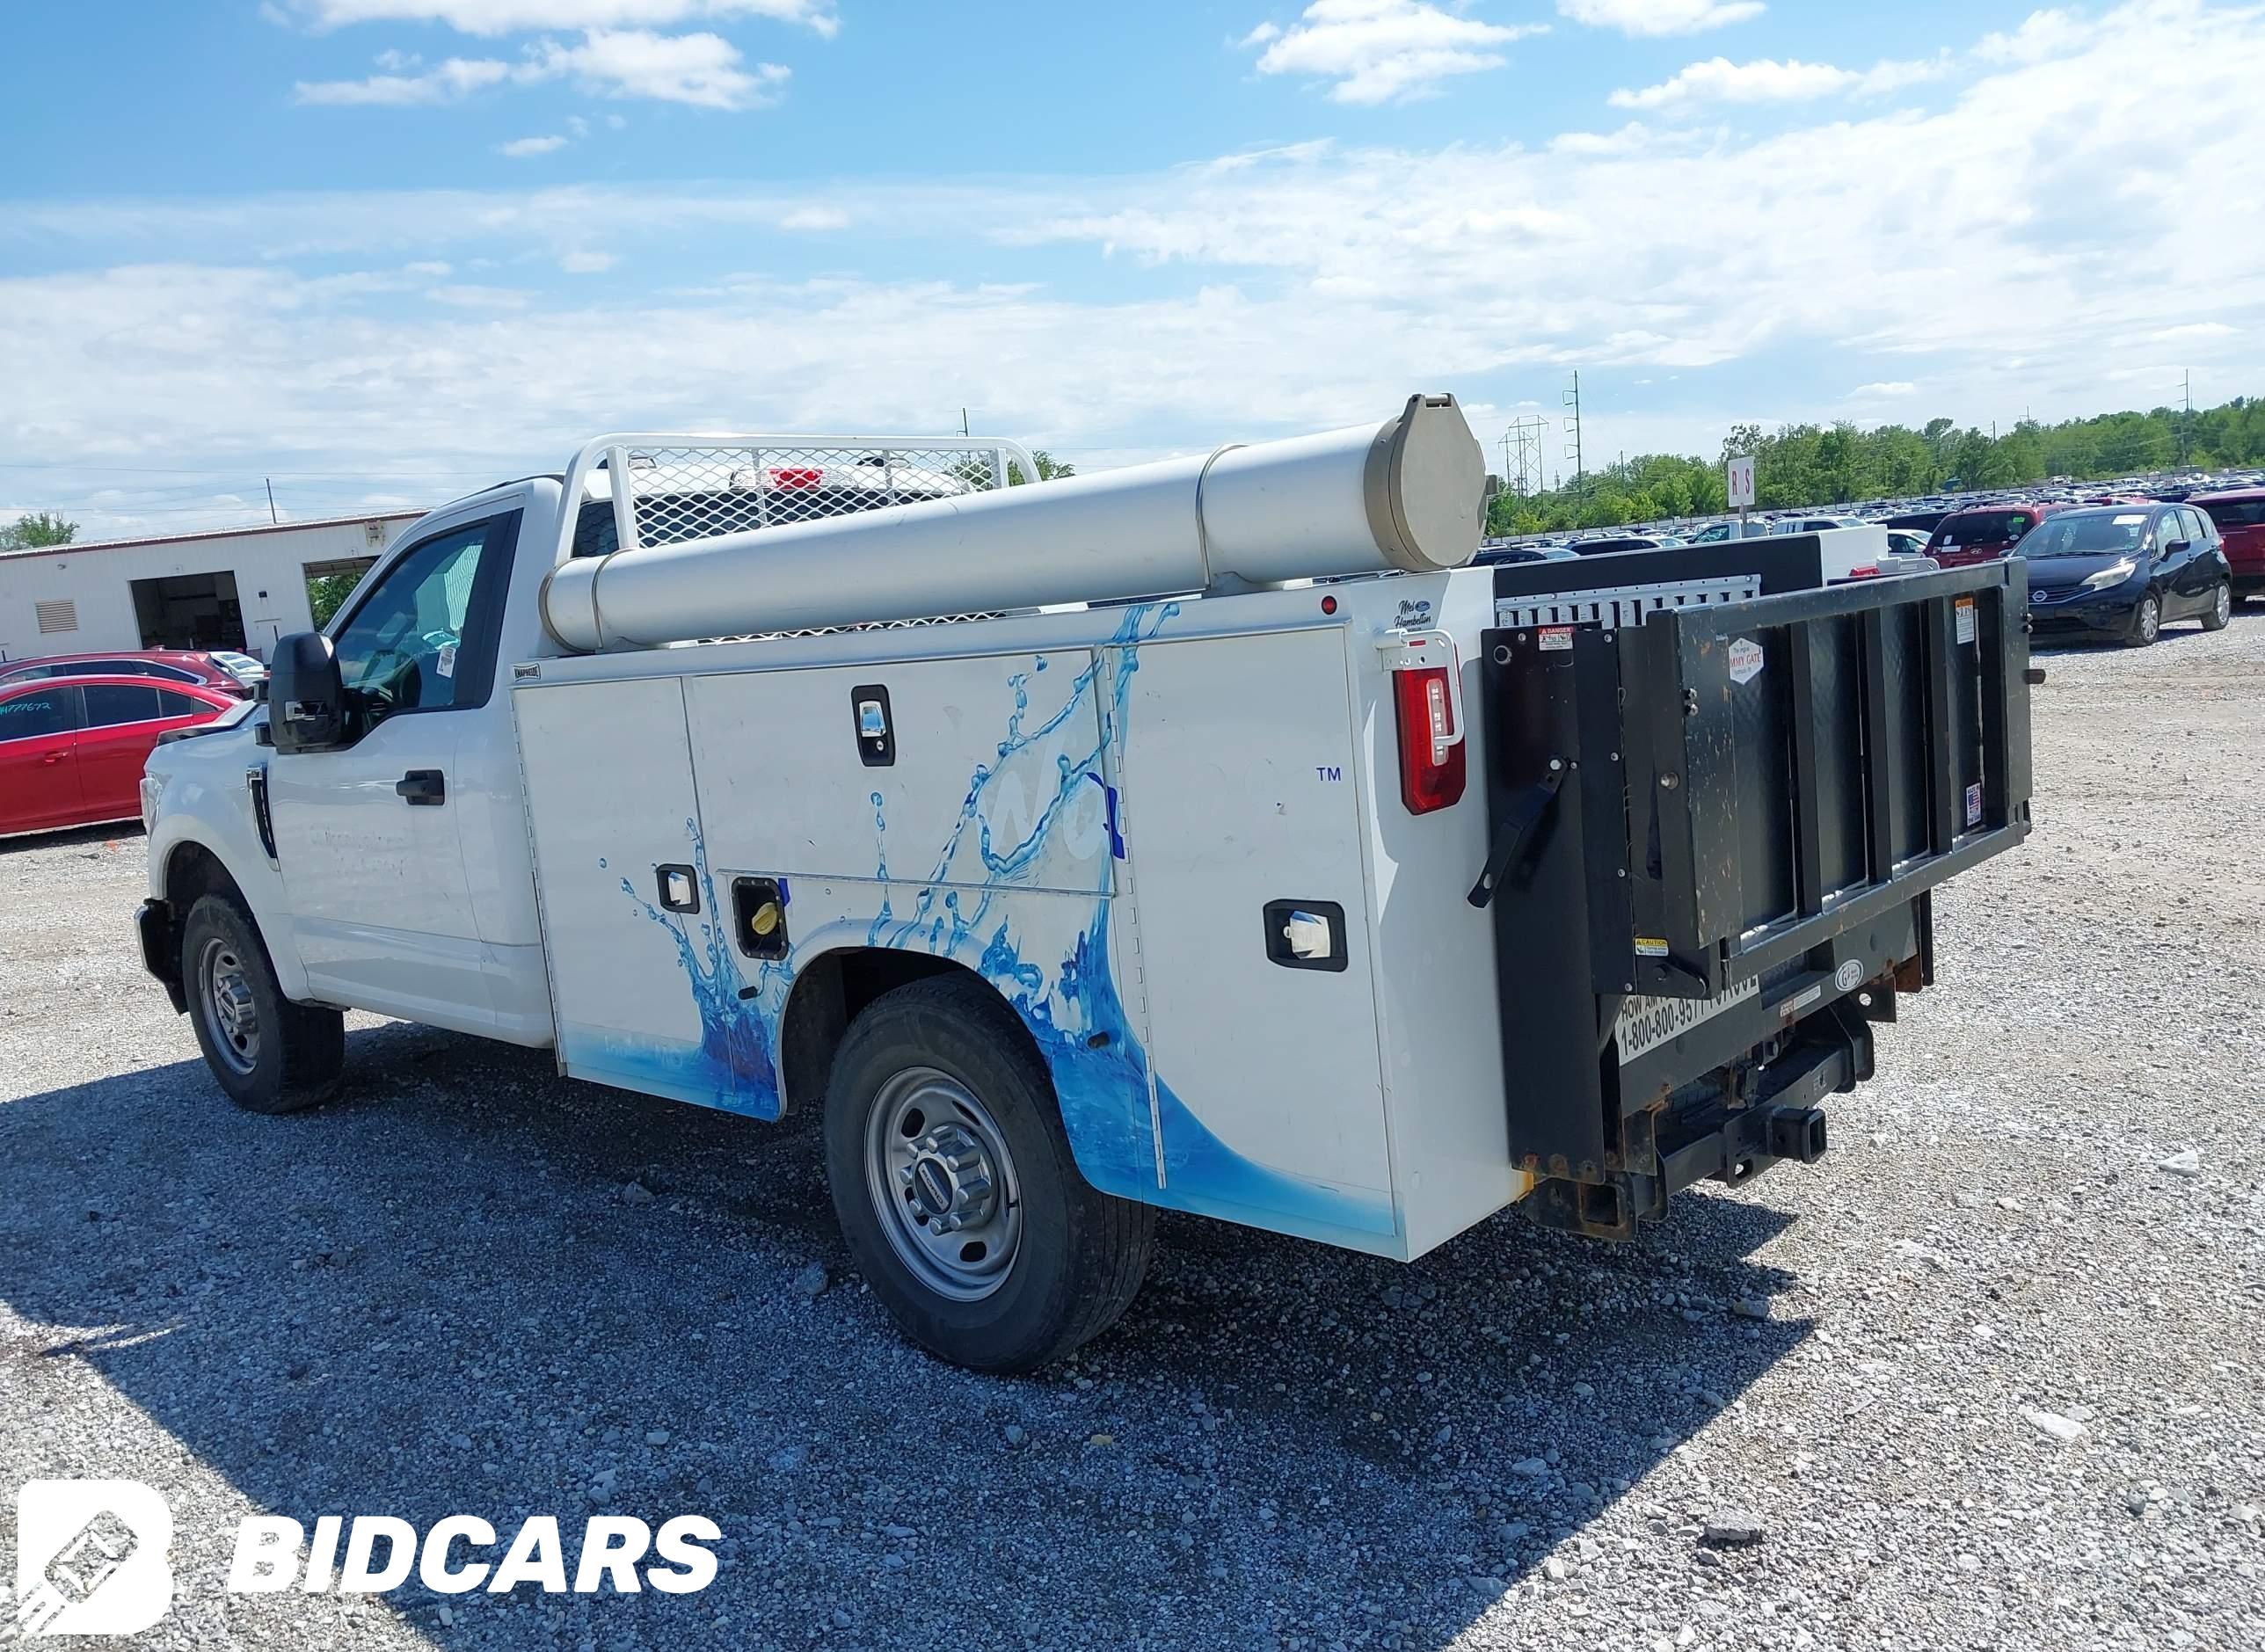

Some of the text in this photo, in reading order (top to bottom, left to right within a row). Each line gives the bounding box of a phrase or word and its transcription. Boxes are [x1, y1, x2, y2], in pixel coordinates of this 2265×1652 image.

[1744, 468, 1751, 494] S
[1730, 653, 1761, 667] MMY GATE
[1315, 767, 1341, 782] TM
[1621, 996, 1642, 1022] HOW
[921, 1169, 943, 1204] FORD
